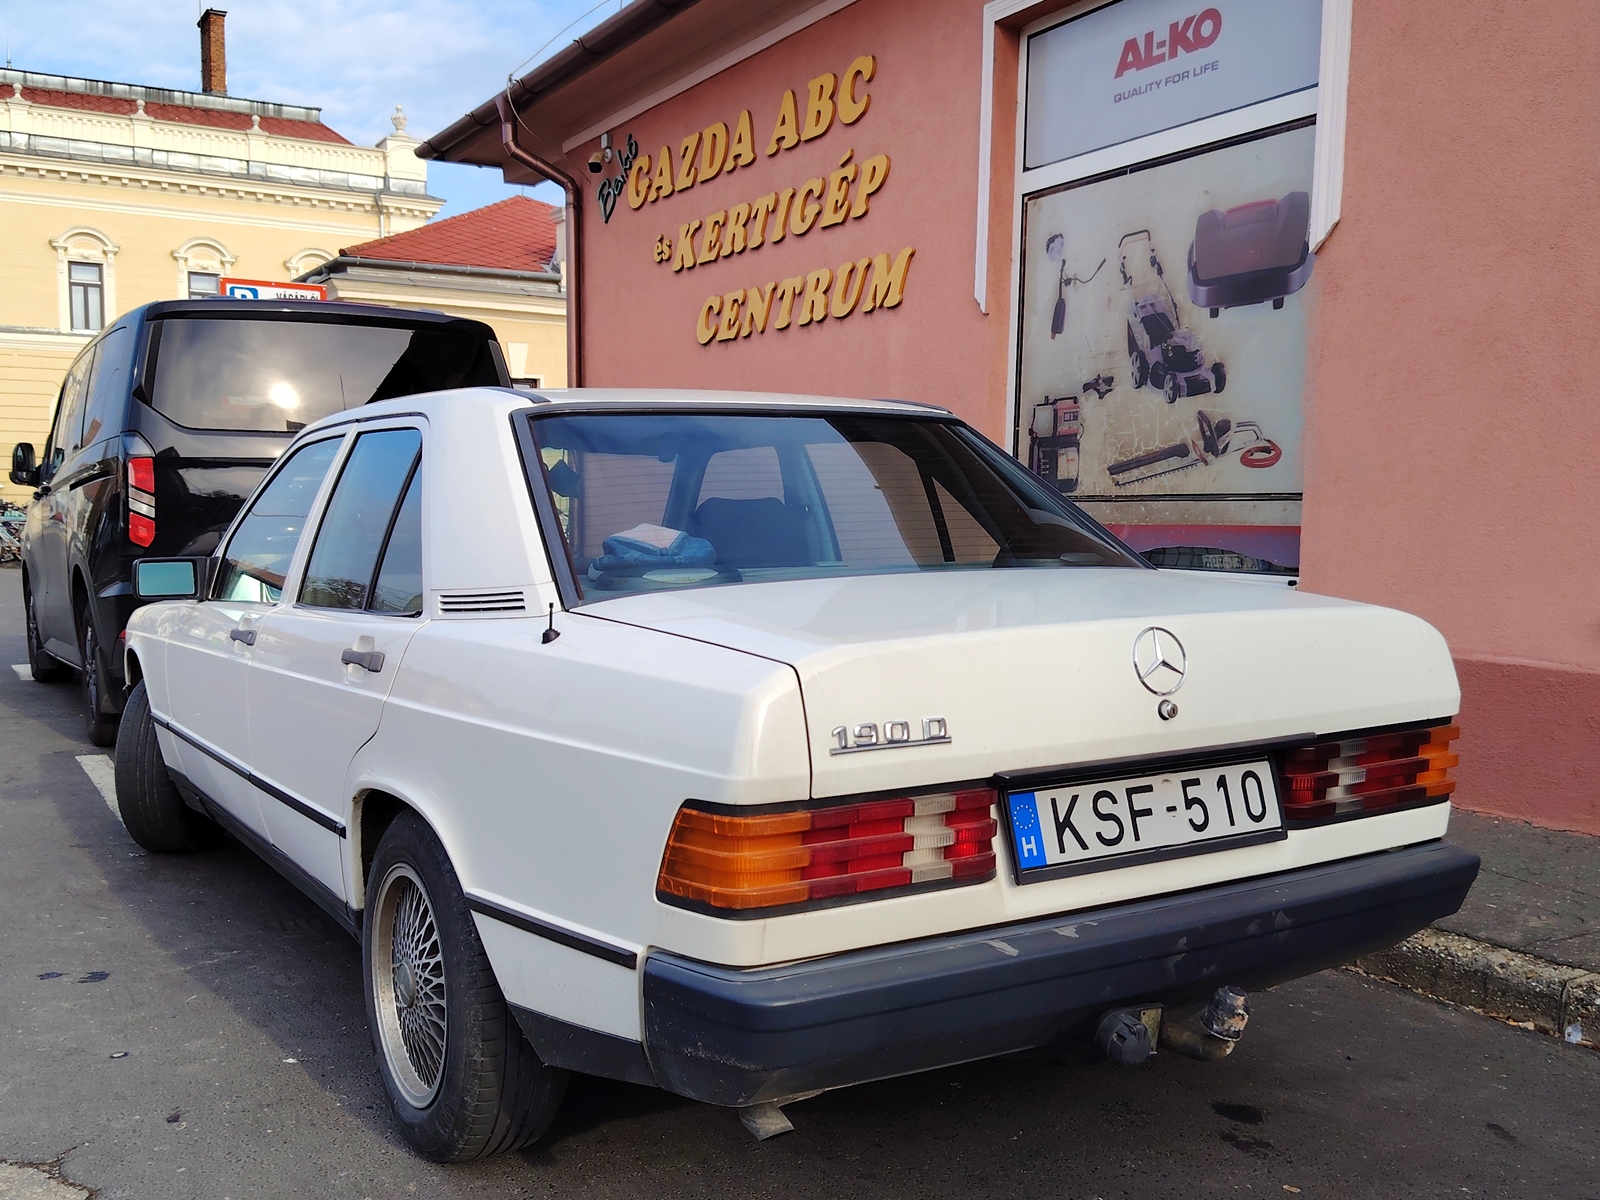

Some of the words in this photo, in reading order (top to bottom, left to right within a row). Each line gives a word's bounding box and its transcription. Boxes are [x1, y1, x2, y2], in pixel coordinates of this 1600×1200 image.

[1113, 7, 1223, 80] AL-KO
[1113, 79, 1163, 104] QUALITY
[1164, 70, 1190, 87] FOR
[1193, 60, 1219, 78] LIFE
[627, 110, 758, 210] GAZDA
[766, 54, 877, 157] ABC
[653, 234, 673, 265] és
[672, 148, 892, 273] KERTIGÉP
[695, 246, 917, 346] CENTRUM
[831, 720, 910, 750] 190
[921, 717, 948, 741] D
[1020, 835, 1038, 858] H
[1050, 769, 1267, 854] KSF-510
